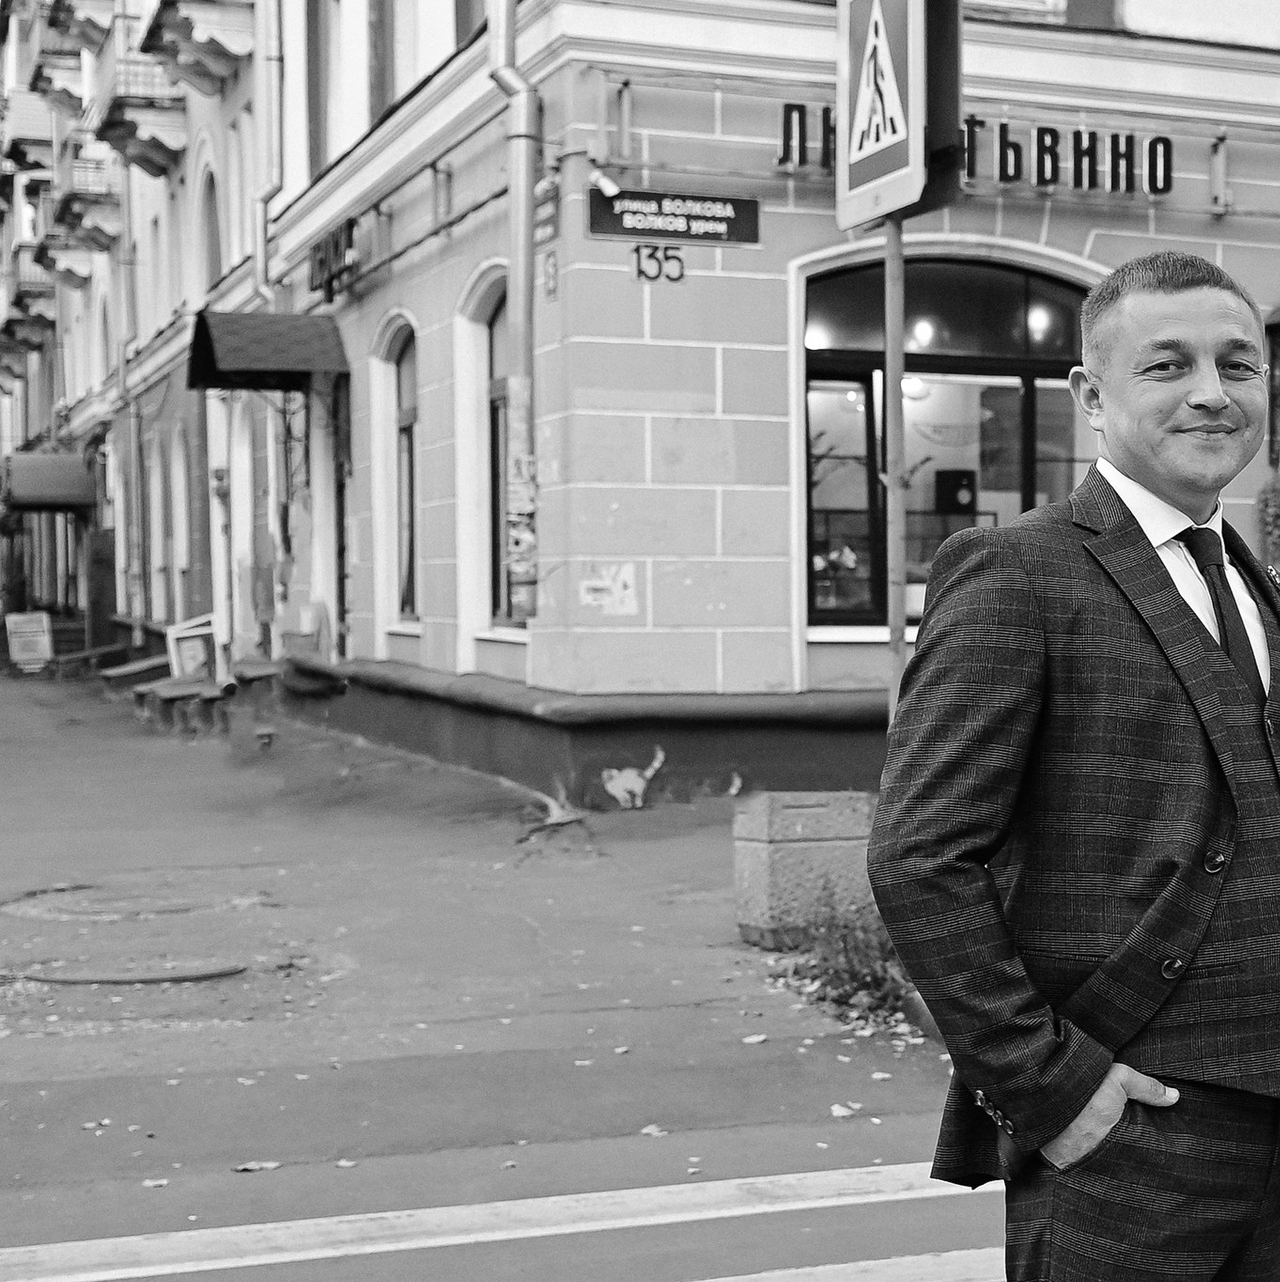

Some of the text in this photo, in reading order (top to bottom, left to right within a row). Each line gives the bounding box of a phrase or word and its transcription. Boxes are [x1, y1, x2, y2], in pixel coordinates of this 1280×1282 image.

[661, 197, 736, 219] ВОЛКОВА
[622, 212, 688, 232] ВОЛКОВ
[634, 244, 684, 282] 135
